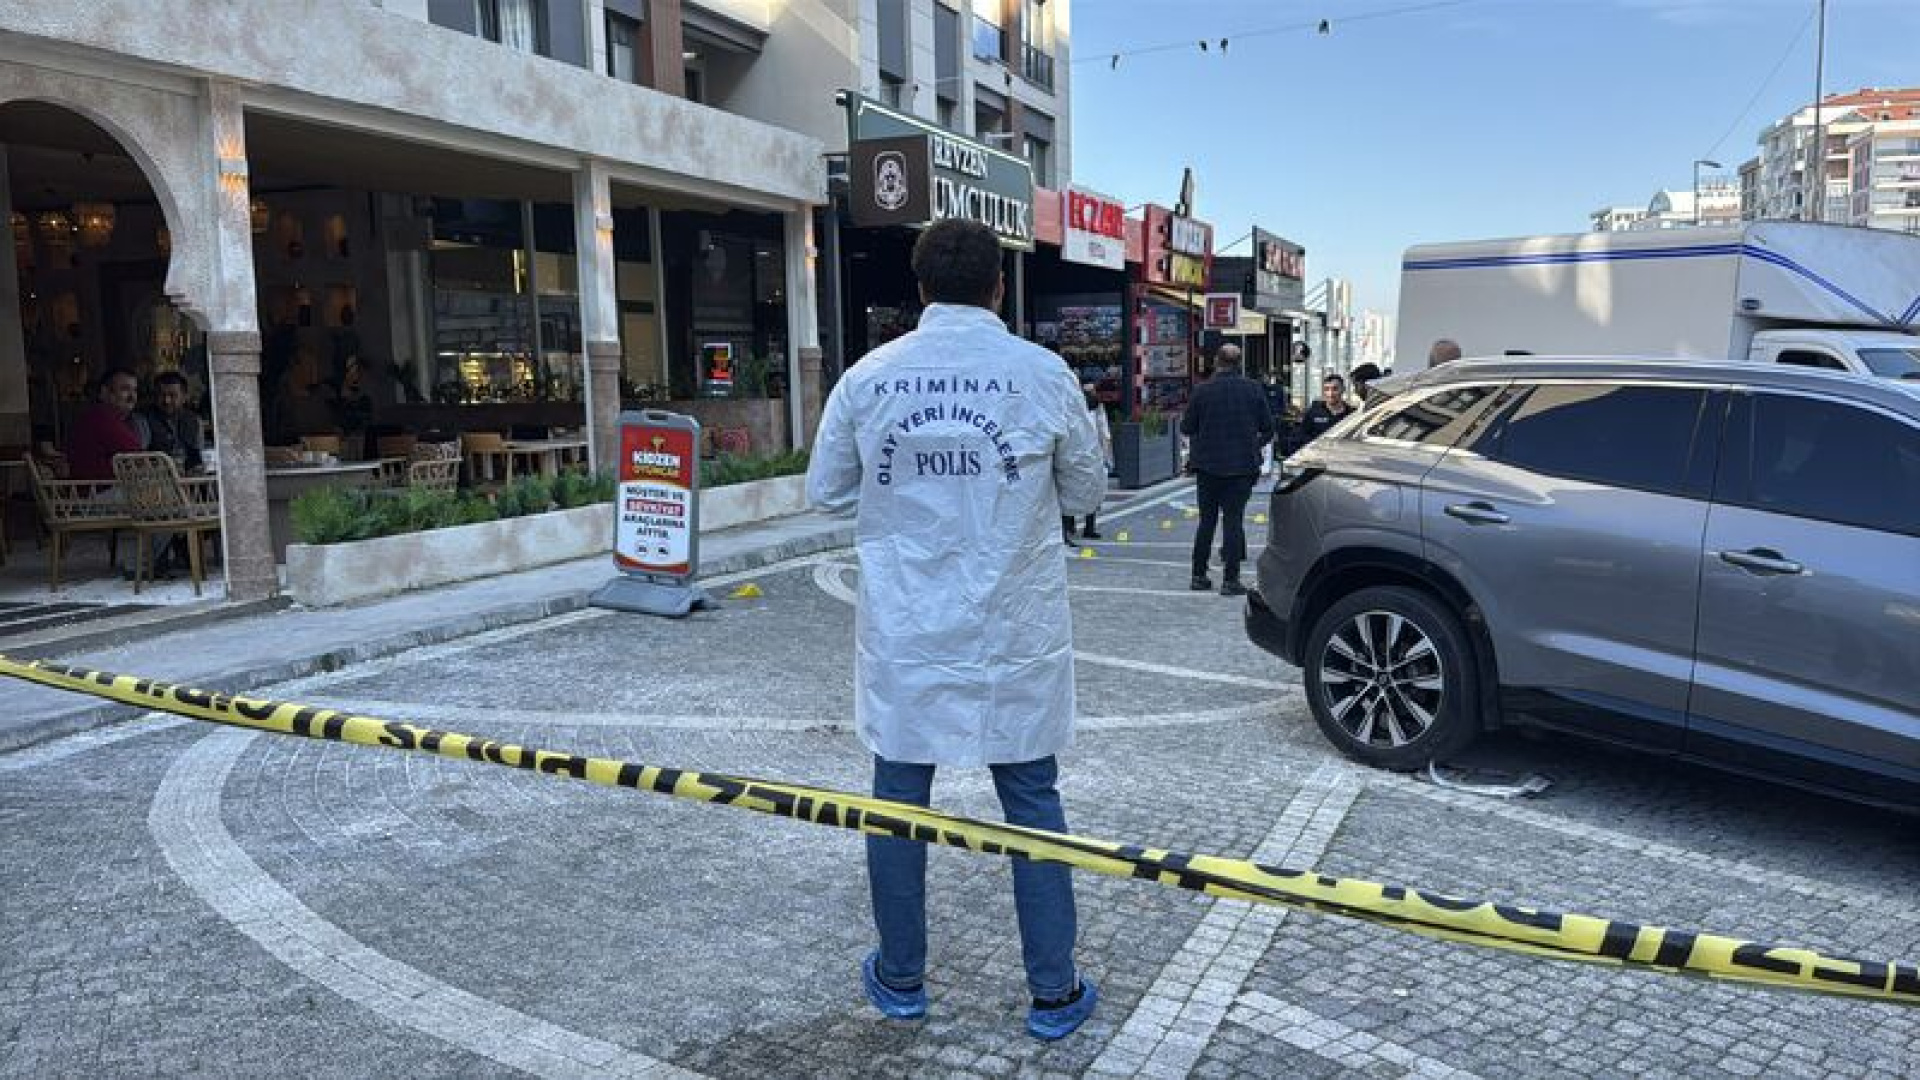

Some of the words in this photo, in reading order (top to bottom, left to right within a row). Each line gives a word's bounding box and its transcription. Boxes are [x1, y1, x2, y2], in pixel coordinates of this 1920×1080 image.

[935, 175, 1029, 236] UMCULUK
[877, 433, 897, 486] OLAY
[898, 402, 945, 432] YERİ
[951, 402, 1021, 485] İNCELEME
[915, 443, 981, 476] POLİS
